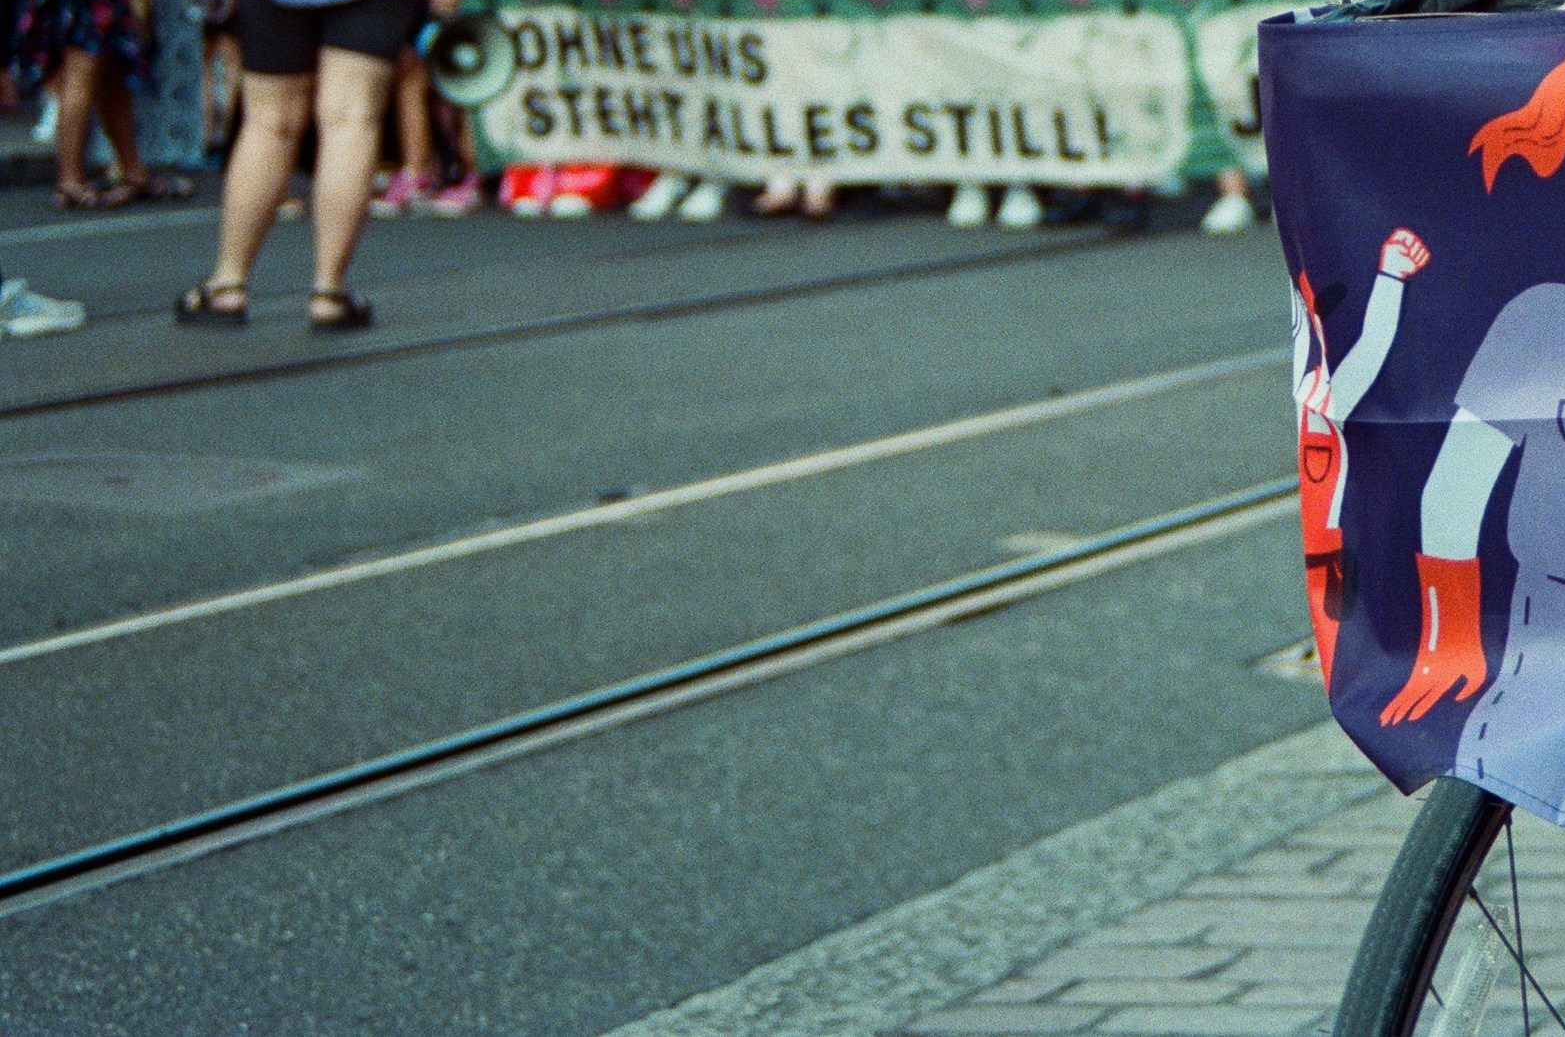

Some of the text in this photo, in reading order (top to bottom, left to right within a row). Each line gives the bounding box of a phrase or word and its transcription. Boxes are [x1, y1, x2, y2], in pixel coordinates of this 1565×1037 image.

[514, 19, 769, 86] OHNE UNS
[522, 87, 1110, 161] STEHT ALLES STILL!
